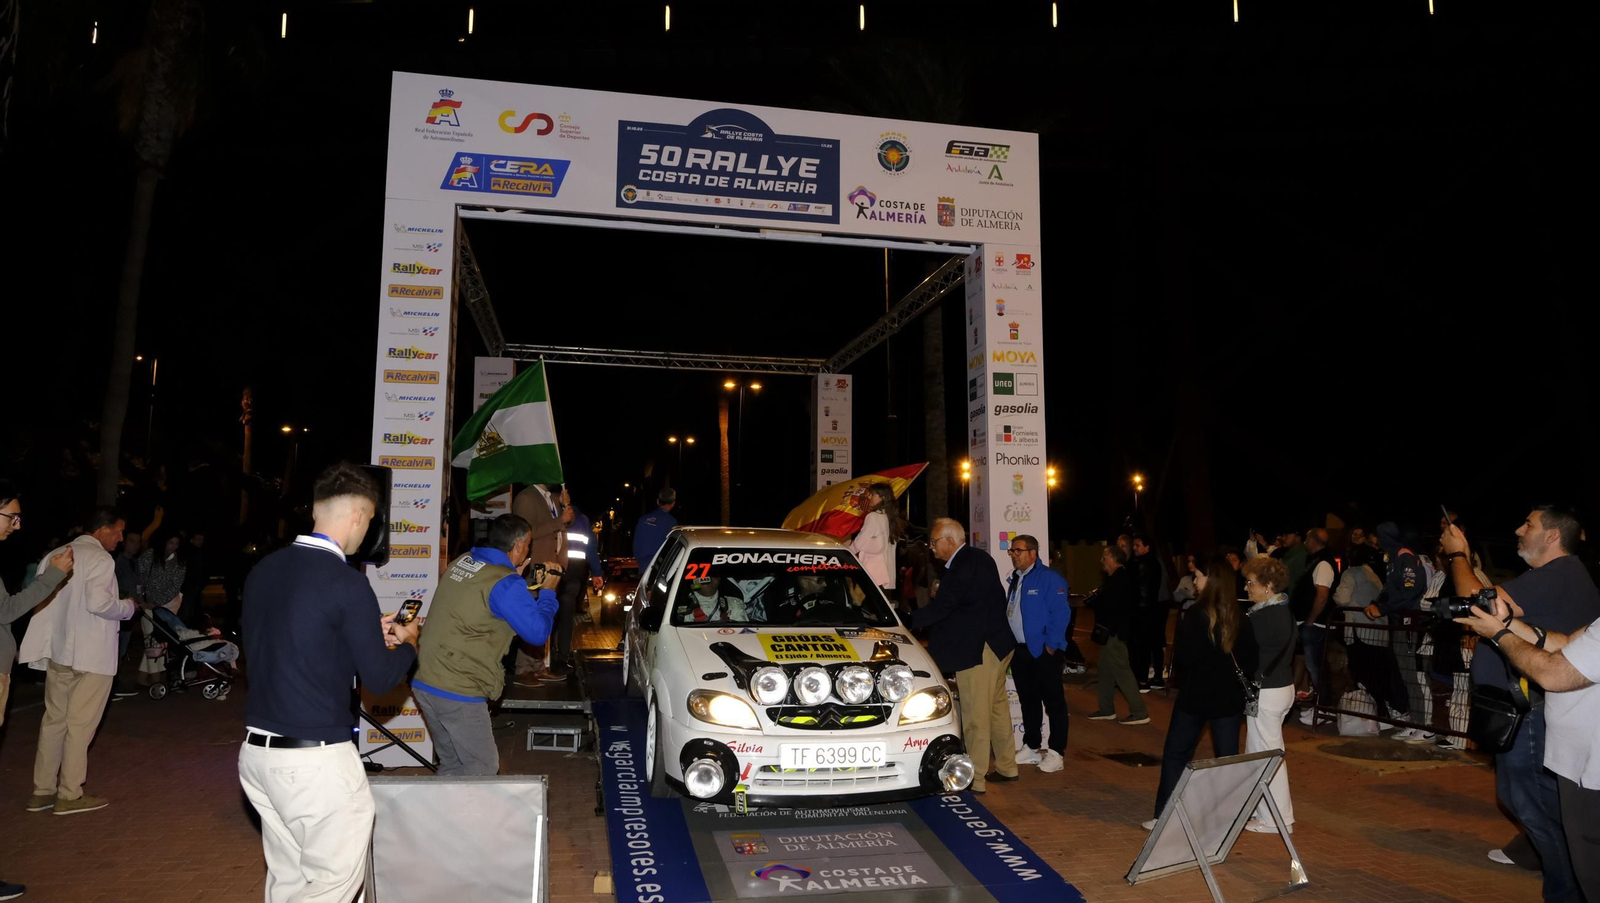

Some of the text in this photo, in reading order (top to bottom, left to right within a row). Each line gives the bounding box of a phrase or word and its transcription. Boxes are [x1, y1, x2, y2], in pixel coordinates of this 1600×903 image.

[489, 159, 554, 176] CERA
[638, 143, 820, 179] 50 RALLYE
[502, 180, 542, 191] Recalvi
[638, 169, 818, 195] COSTA DE ALMERÍA
[879, 199, 926, 211] COSTA DE
[869, 209, 927, 225] ALMERÍA
[960, 207, 1023, 221] DIPUTACIÓN
[960, 218, 1021, 231] DE ALMERÍA
[392, 262, 443, 276] Rallycar
[399, 286, 433, 297] Recalvi
[388, 347, 439, 360] Rallycar
[992, 350, 1038, 363] MOYA
[394, 372, 428, 382] Recalvi
[969, 404, 986, 422] gasolia
[994, 402, 1039, 416] gasolia
[383, 433, 434, 445] Rallycar
[1012, 429, 1039, 437] Fornieles
[390, 458, 424, 468] Recalvi
[995, 452, 1040, 466] Phonika
[820, 467, 848, 476] gasolia
[389, 521, 430, 533] allycar
[711, 552, 842, 567] BONACHERA
[684, 563, 711, 580] 27
[786, 561, 859, 574] competición
[770, 643, 848, 652] CANTON
[726, 740, 764, 754] Silvia
[902, 736, 929, 752] Arya
[791, 745, 882, 765] TF 6399 CC
[852, 808, 908, 817] VALENCIANA
[777, 831, 895, 844] DIPUTACIÓN
[940, 795, 1043, 881] www.garcia
[783, 838, 899, 852] DE ALMERÍA
[819, 865, 917, 878] COSTA DE
[806, 874, 928, 891] ALMERÍA
